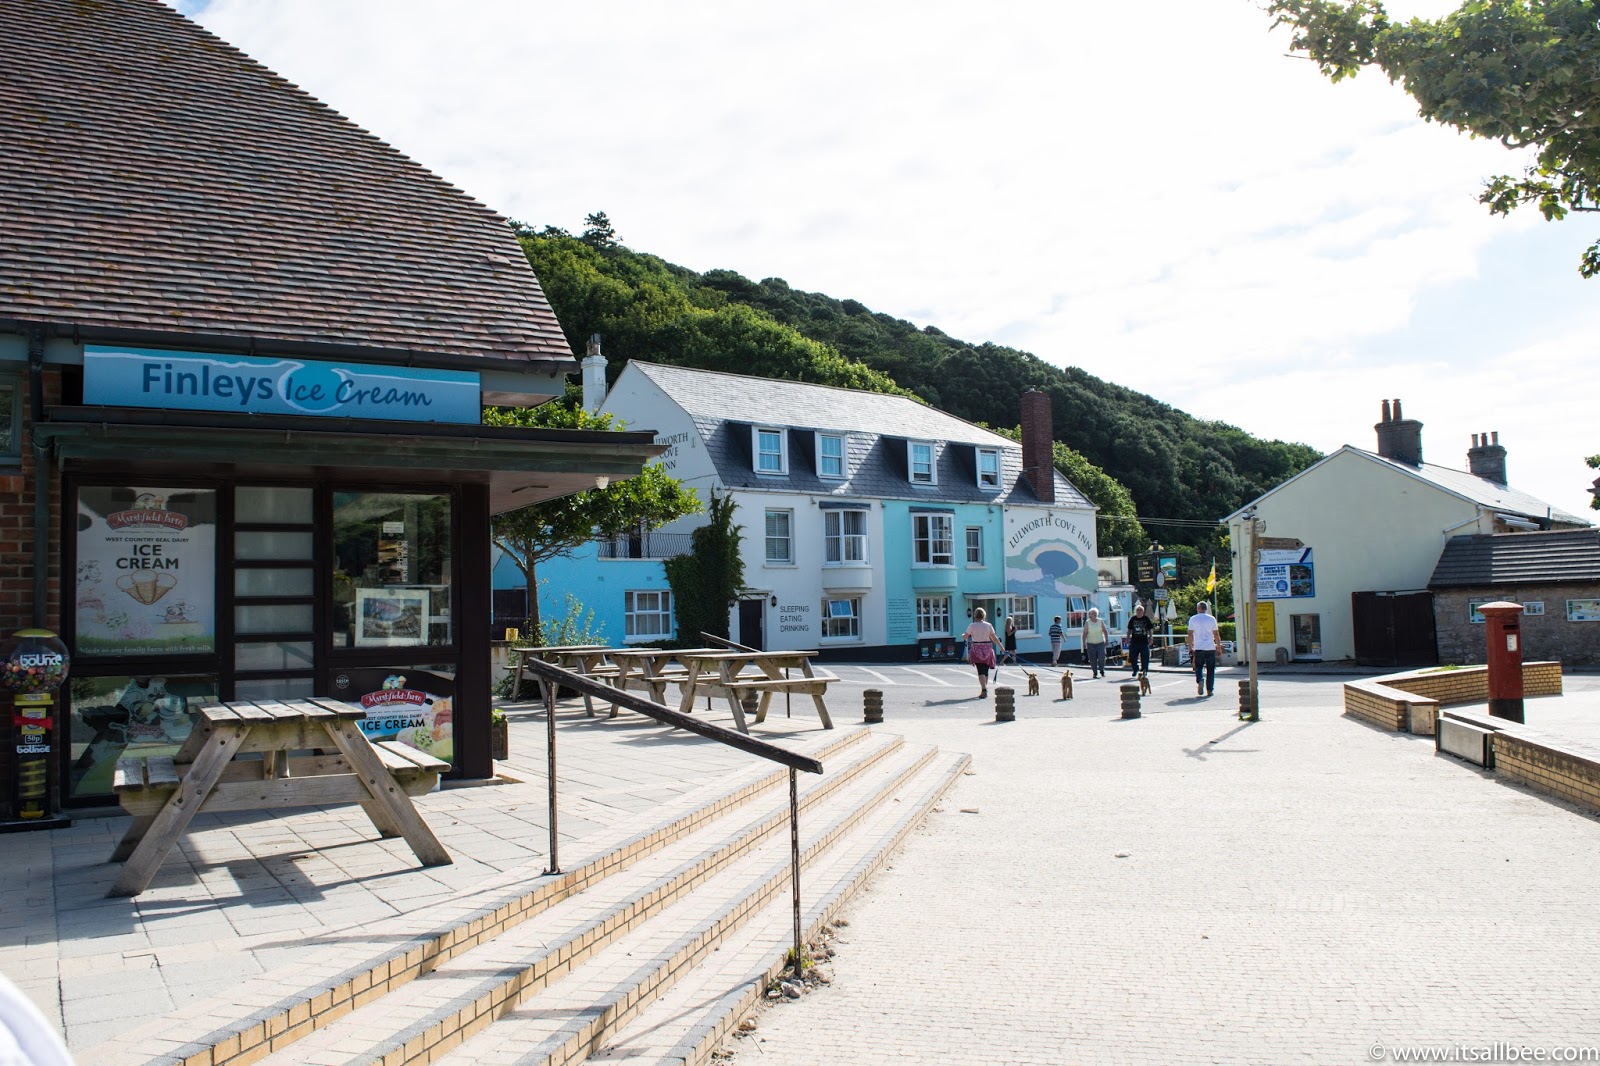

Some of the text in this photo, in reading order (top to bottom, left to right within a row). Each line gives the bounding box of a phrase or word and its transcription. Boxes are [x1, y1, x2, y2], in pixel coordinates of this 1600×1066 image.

[142, 362, 433, 407] Finleys Ice Cream
[1009, 517, 1093, 551] LULWORTH COVE INN
[133, 544, 162, 556] ICE
[116, 557, 179, 570] CREAM
[124, 646, 145, 654] family
[362, 719, 426, 731] ICE CREAM
[27, 735, 41, 743] 50p
